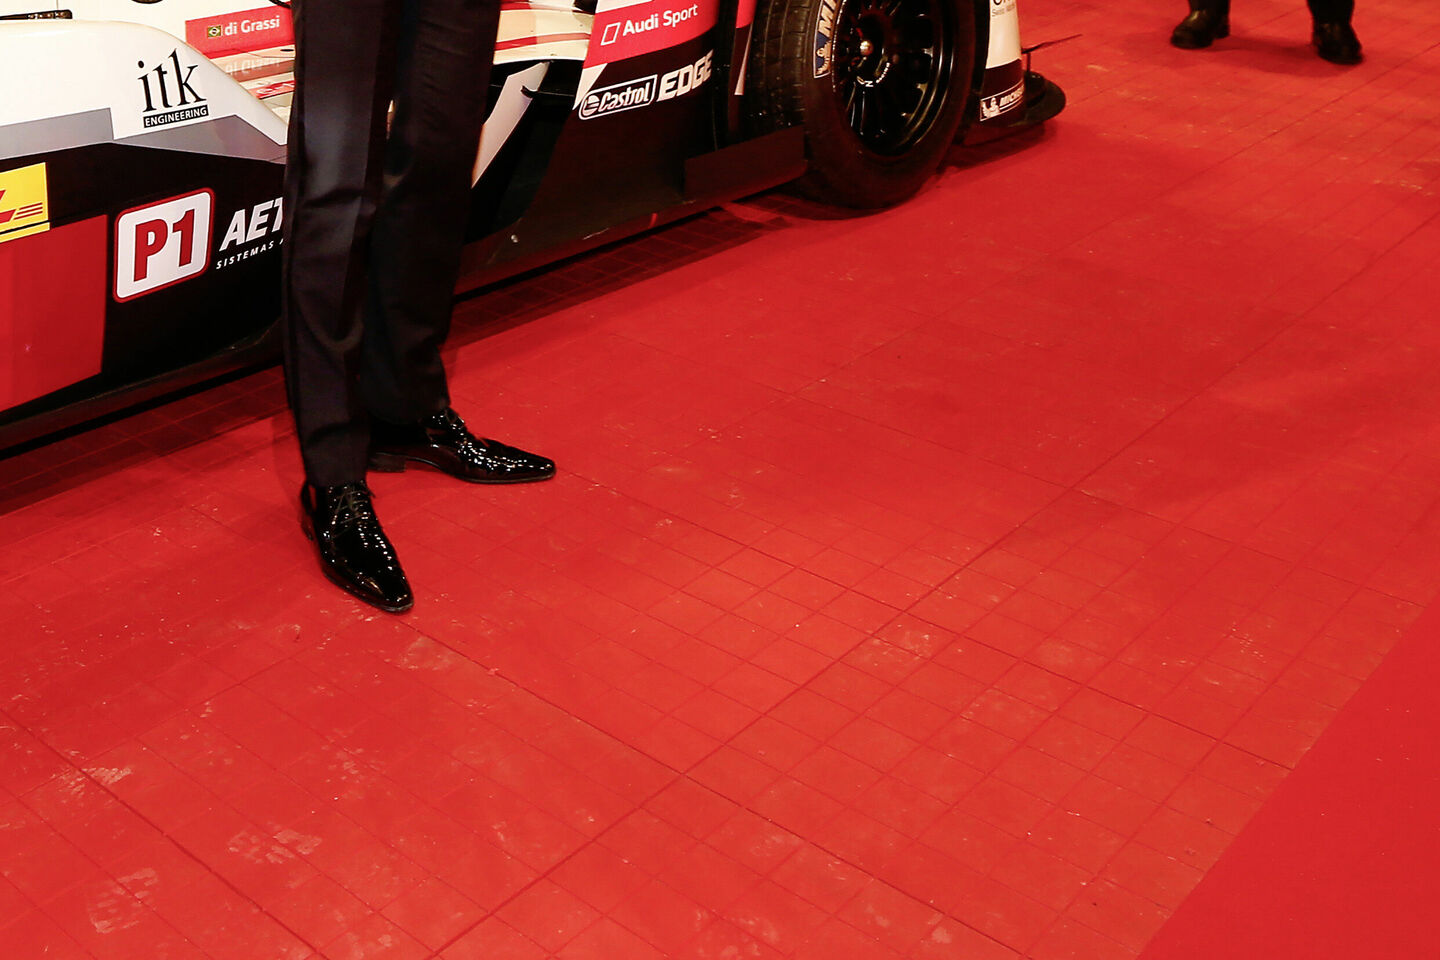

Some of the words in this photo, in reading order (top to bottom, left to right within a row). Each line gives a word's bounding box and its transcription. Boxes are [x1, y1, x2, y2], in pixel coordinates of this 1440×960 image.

[224, 19, 237, 36] di
[241, 15, 280, 33] Grassi
[622, 14, 658, 37] Audi
[663, 4, 698, 27] Sport
[137, 48, 207, 112] itk
[598, 82, 650, 112] Castrol
[656, 49, 713, 102] EDGE
[144, 107, 208, 128] ENGINEERING
[133, 209, 194, 283] P1
[215, 240, 275, 270] SISTEMAS
